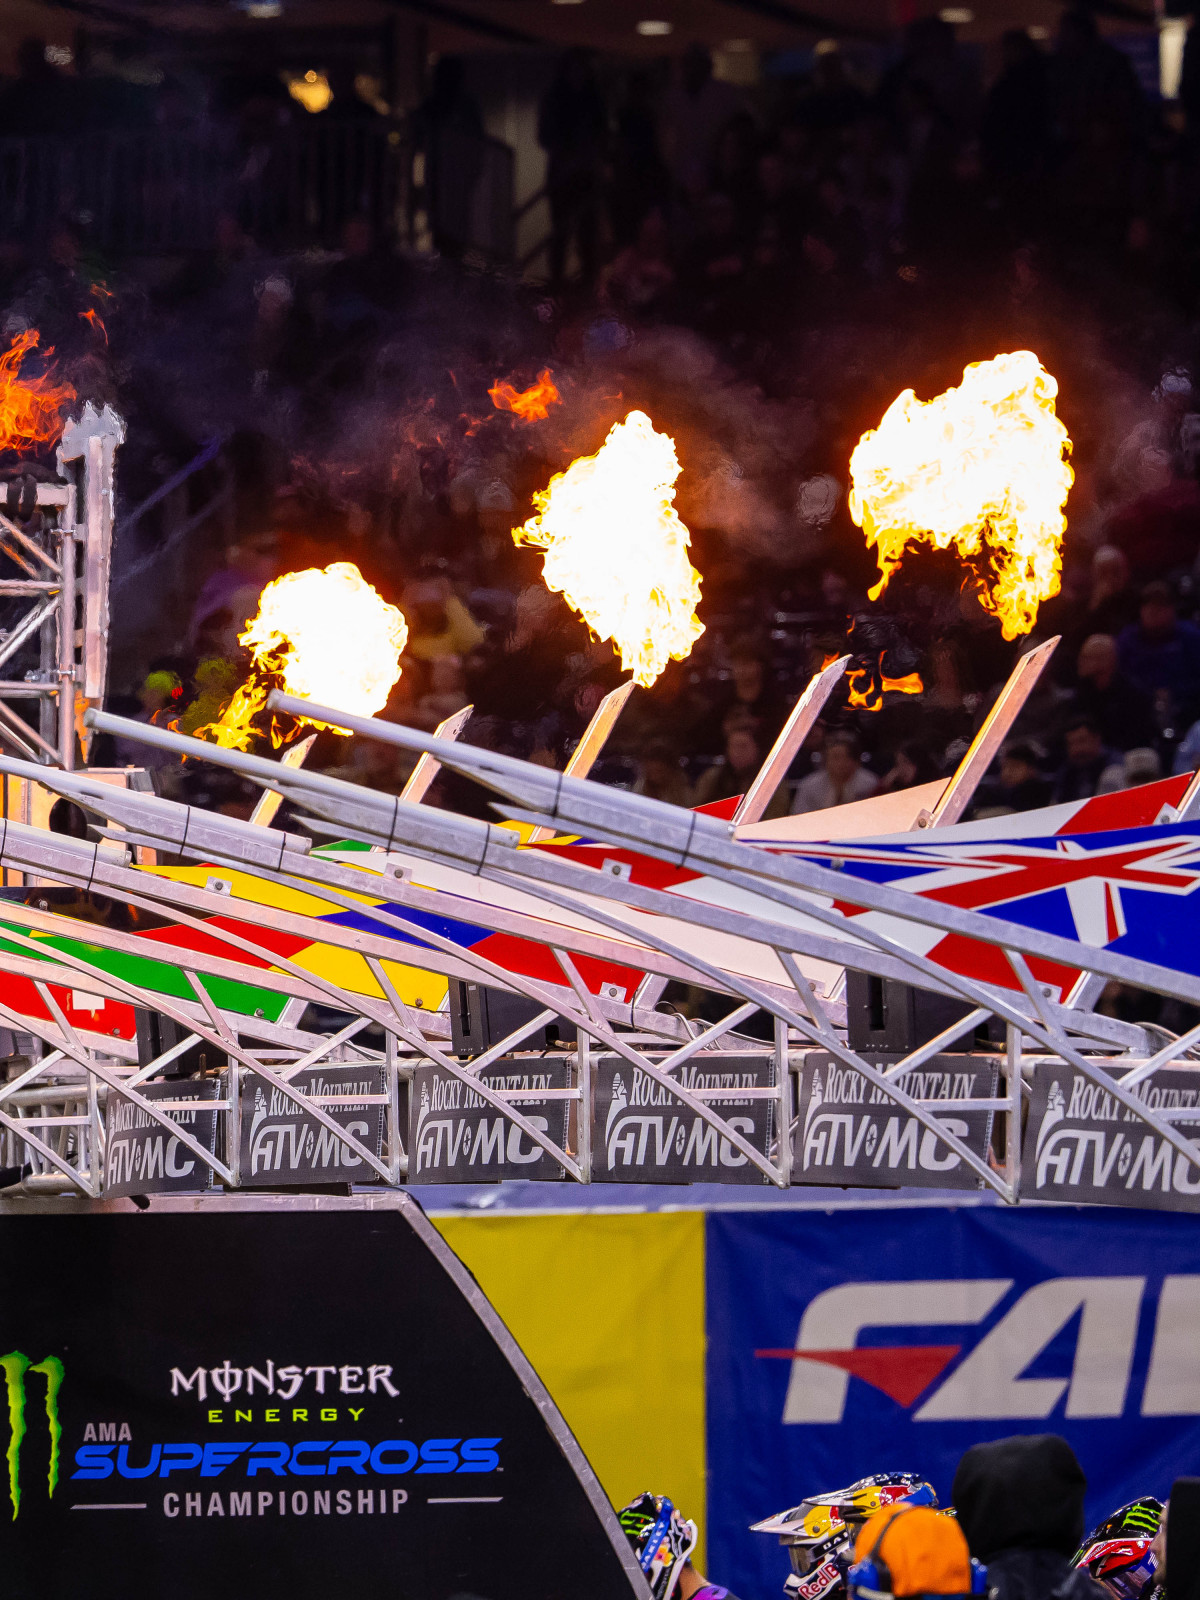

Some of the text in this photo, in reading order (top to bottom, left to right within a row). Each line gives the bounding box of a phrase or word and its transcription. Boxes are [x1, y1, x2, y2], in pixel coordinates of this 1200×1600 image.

[268, 1085, 308, 1116] ROCKY
[431, 1074, 463, 1111] ROCKY
[677, 1066, 758, 1106] MOUNTAIN
[823, 1062, 977, 1105] ROCKY MUNTAIN
[1066, 1076, 1200, 1127] ROCKY MOUNT
[169, 1359, 400, 1402] MONSTER
[83, 1422, 132, 1442] AMA
[208, 1408, 365, 1422] ENERGY
[70, 1438, 503, 1480] SUPERCROSS
[163, 1489, 409, 1518] CHAMPIONSHIP
